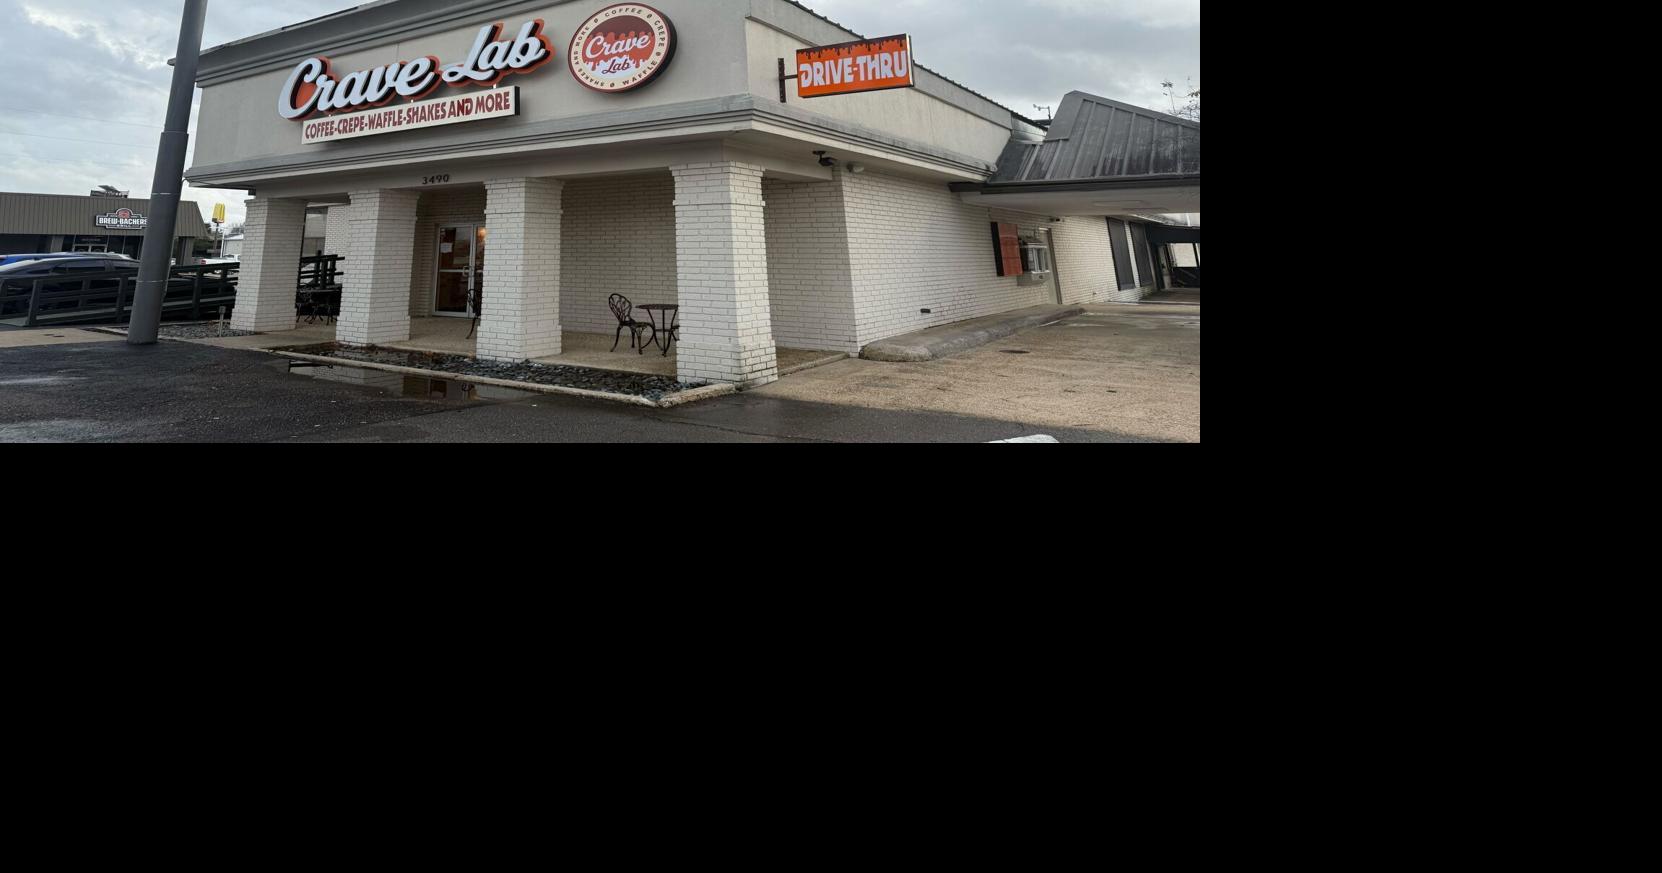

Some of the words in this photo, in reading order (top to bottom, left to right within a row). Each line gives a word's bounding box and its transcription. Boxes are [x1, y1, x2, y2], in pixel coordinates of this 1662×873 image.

[604, 8, 642, 17] COFFEE
[576, 27, 589, 46] MORE
[654, 20, 666, 47] CREPE
[586, 35, 651, 59] Crave
[279, 56, 436, 119] Crave
[442, 20, 546, 82] Lab
[578, 68, 604, 86] SHAKES
[602, 59, 631, 74] Lab
[622, 61, 658, 85] WAFFLE
[799, 50, 907, 88] DRIVE-THRU
[305, 101, 447, 139] COFFEE-CREPE-WAFFLE-SHAKES
[448, 98, 473, 118] AND
[475, 91, 510, 113] MORE
[422, 174, 449, 185] 3490
